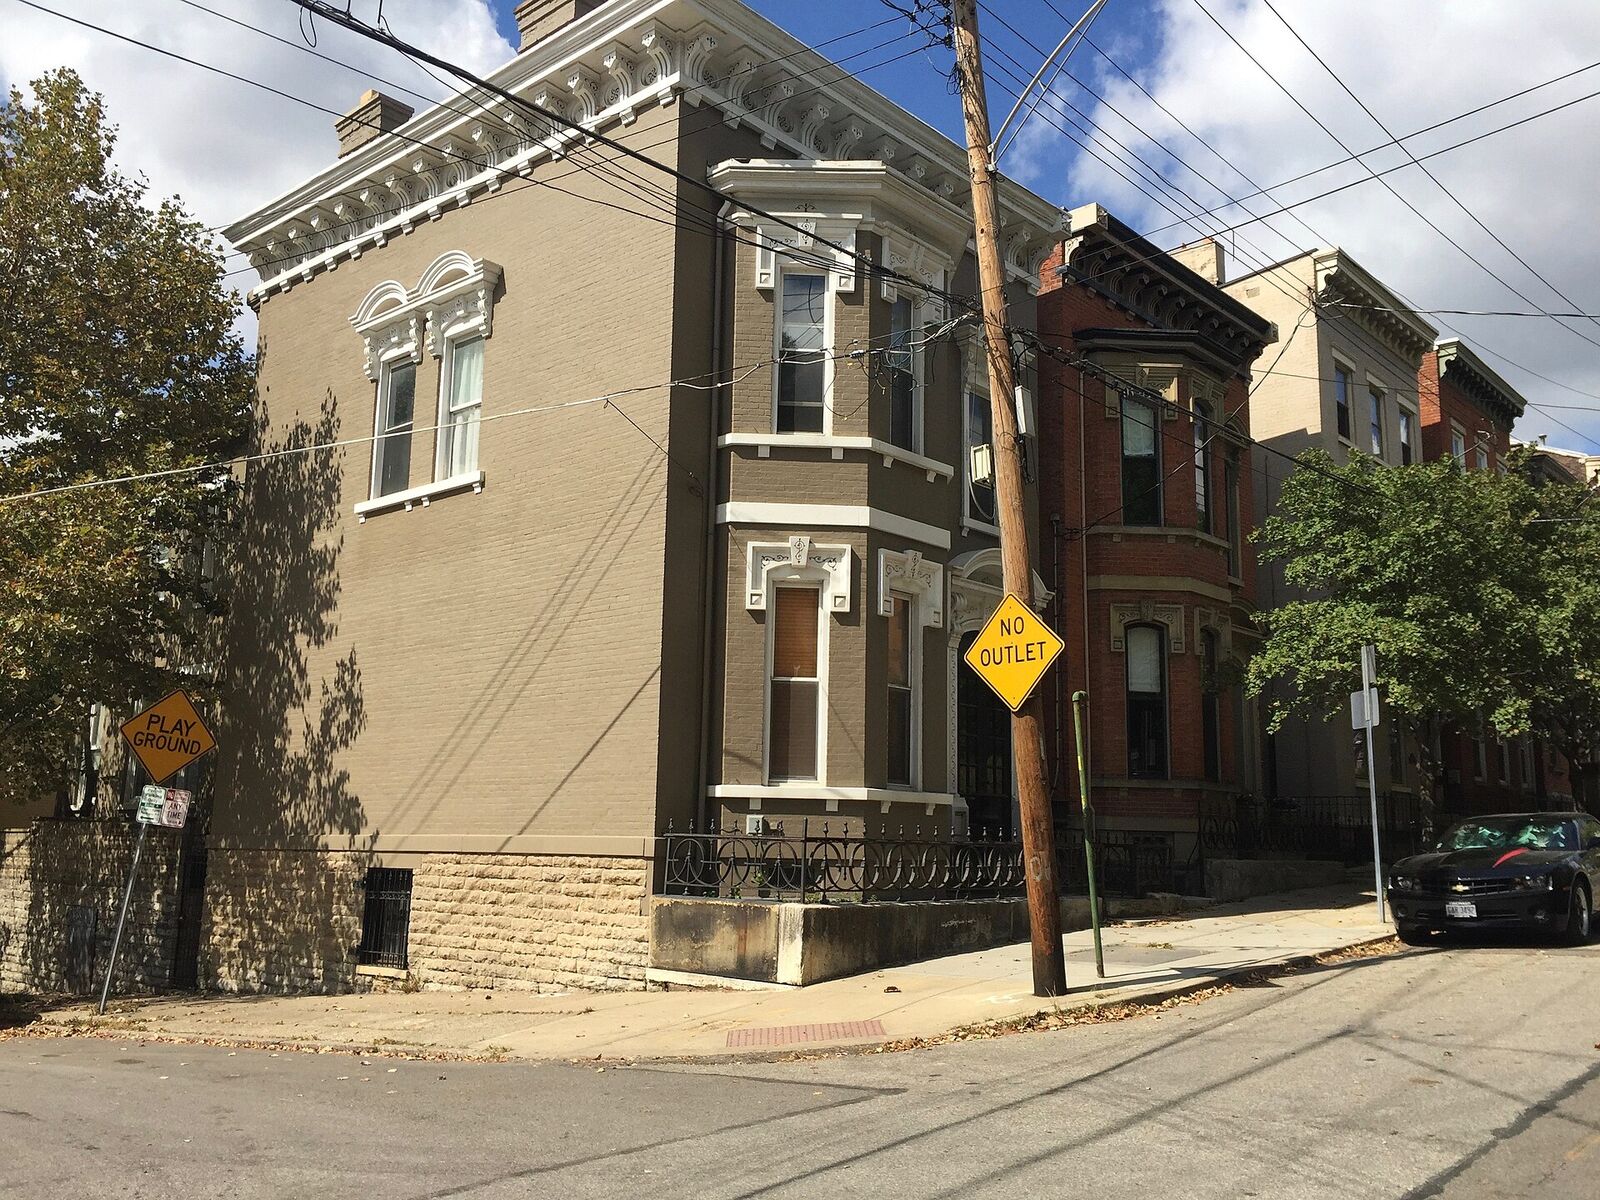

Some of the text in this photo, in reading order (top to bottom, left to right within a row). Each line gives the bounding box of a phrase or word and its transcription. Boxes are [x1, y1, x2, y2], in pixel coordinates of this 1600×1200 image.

[1000, 616, 1025, 637] NO
[980, 641, 1047, 667] OUTLET
[146, 713, 197, 737] PLAY
[133, 731, 201, 755] GROUND
[167, 810, 182, 819] TIME
[168, 802, 182, 810] ANY
